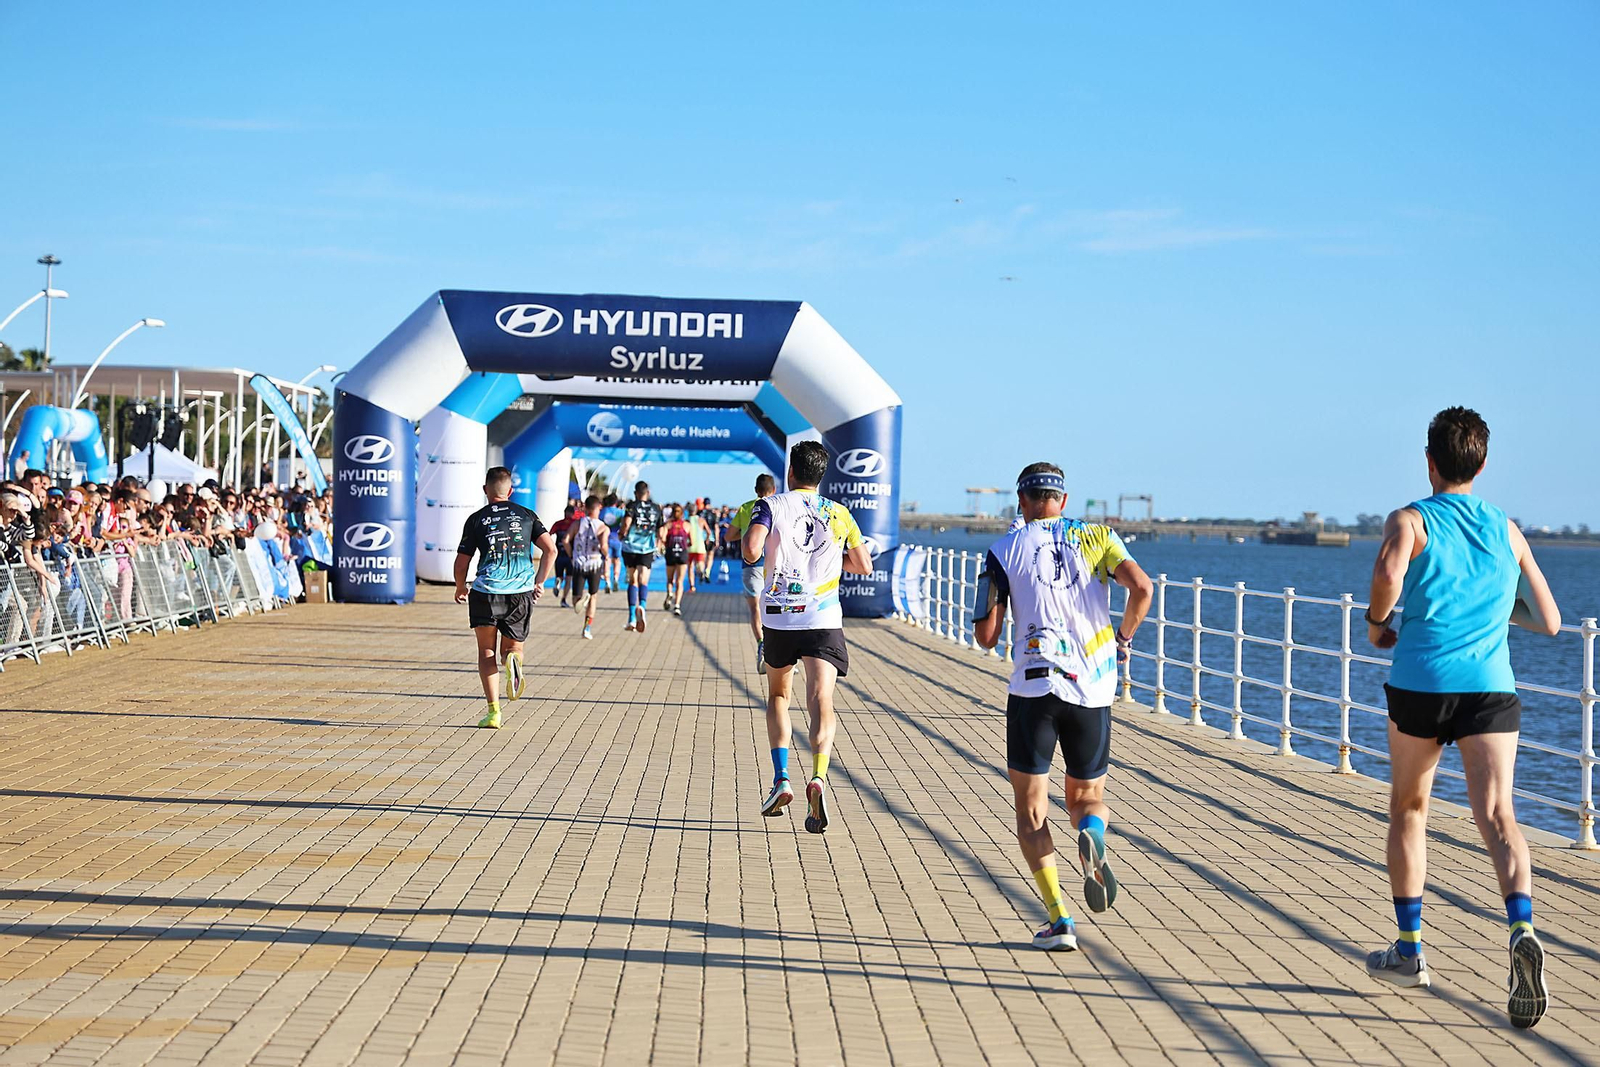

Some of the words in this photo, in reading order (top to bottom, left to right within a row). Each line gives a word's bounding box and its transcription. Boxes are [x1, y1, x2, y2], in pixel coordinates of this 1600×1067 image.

[573, 309, 744, 338] HYUNDAI
[610, 346, 703, 372] Syrluz
[629, 425, 669, 437] Puerto
[671, 425, 687, 437] de
[689, 426, 730, 438] Huelva
[339, 470, 403, 482] HYUNDAI
[350, 484, 389, 498] Syrluz
[829, 483, 892, 496] HYUNDAI
[841, 497, 879, 510] Syrluz
[338, 557, 402, 569] HYUNDAI
[349, 571, 388, 585] Syrluz
[838, 584, 876, 597] Syrluz
